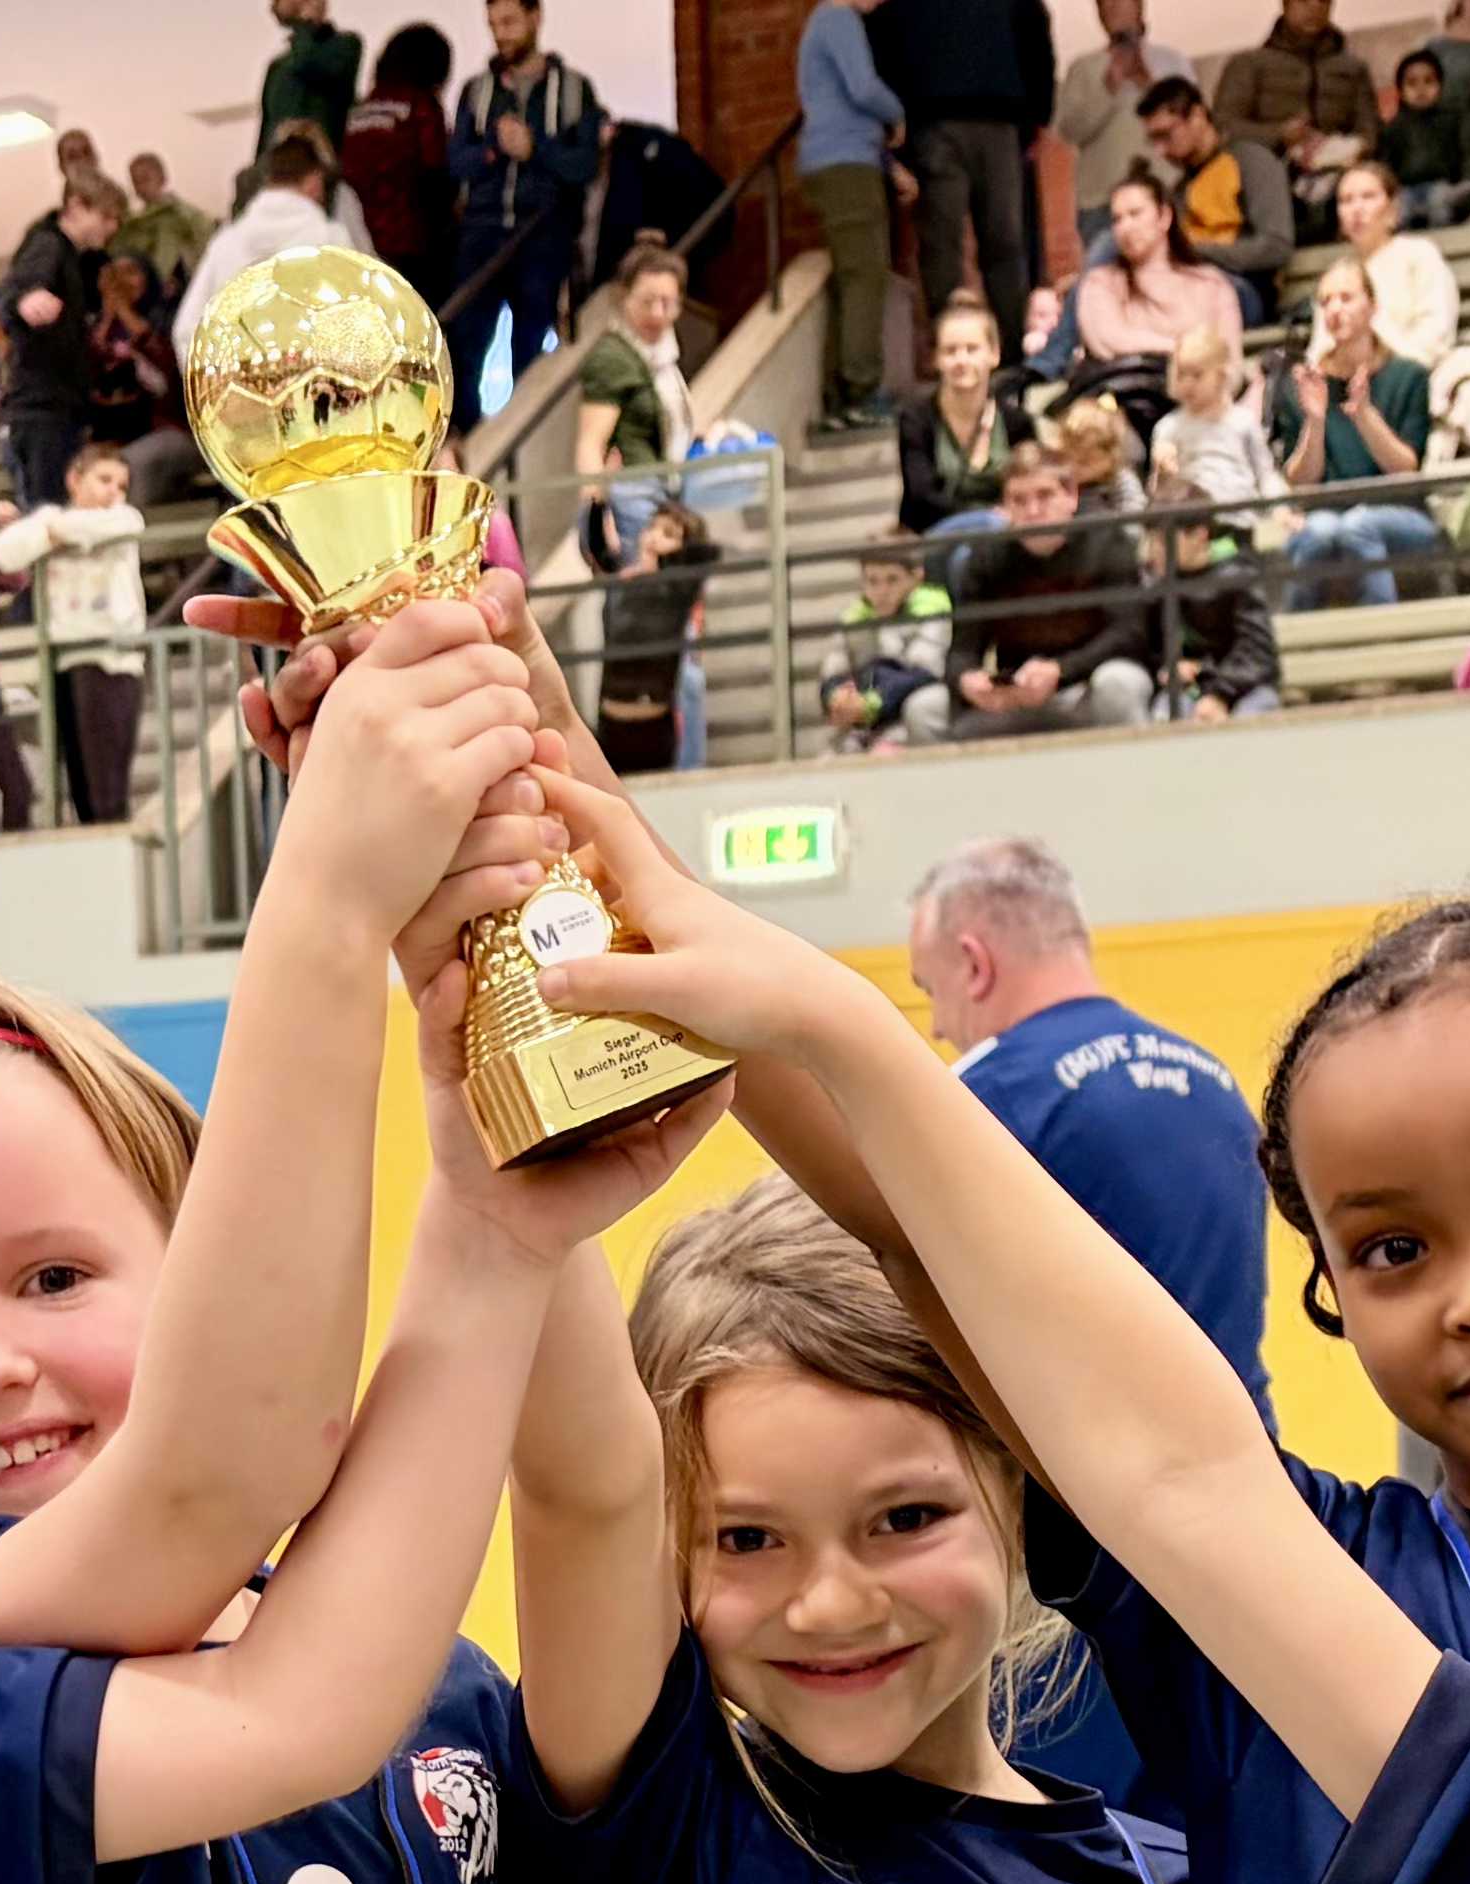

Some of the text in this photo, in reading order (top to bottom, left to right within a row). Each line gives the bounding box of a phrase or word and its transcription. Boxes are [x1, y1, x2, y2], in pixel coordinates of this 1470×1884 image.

[531, 923, 560, 952] M
[604, 1032, 641, 1052] Sieger
[574, 1031, 685, 1081] Munich Airport Cup
[439, 1837, 467, 1852] 2012
